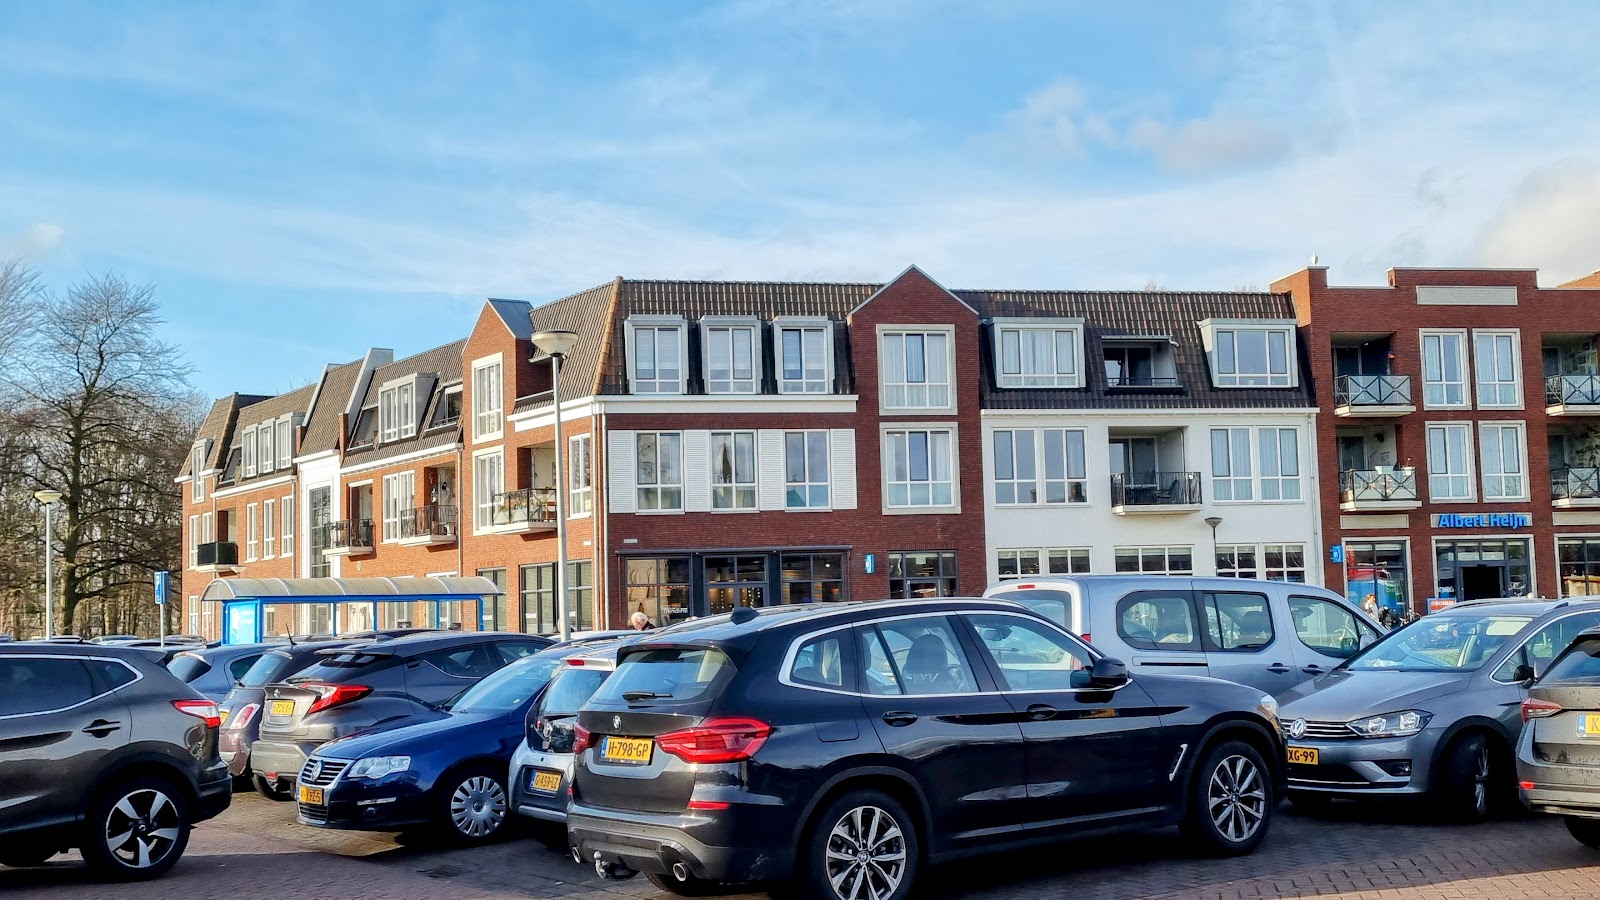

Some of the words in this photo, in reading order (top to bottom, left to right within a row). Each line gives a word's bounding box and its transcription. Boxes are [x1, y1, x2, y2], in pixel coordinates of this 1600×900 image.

[1438, 513, 1486, 527] Albert
[1489, 513, 1528, 529] Heijn
[607, 741, 649, 758] H-798-GP
